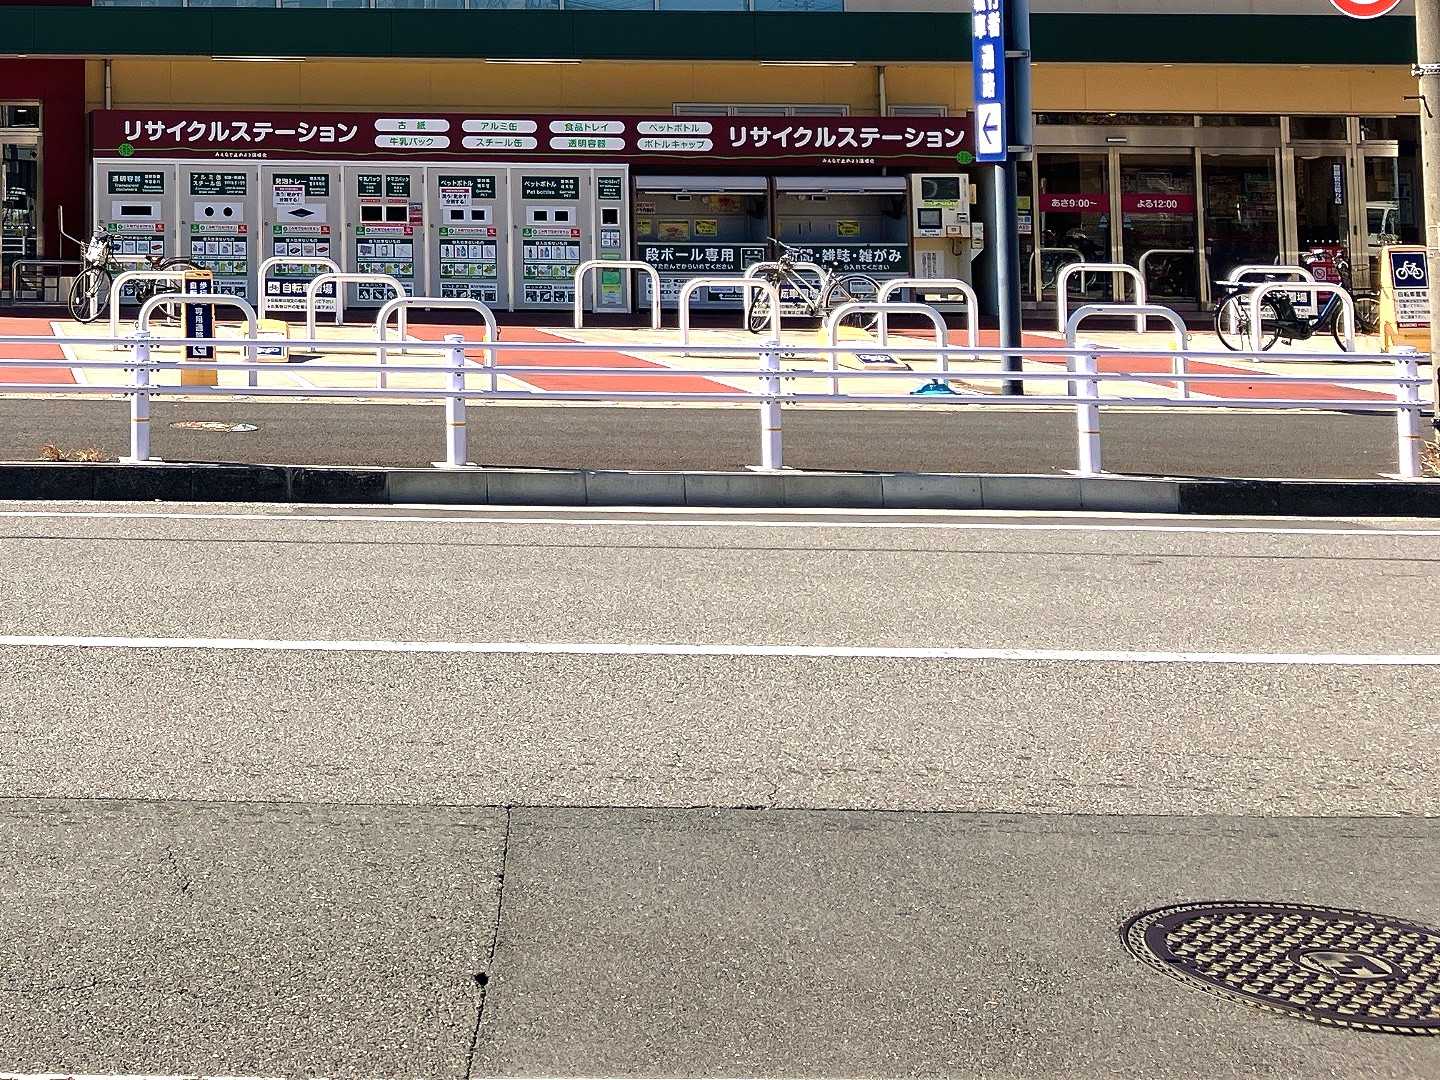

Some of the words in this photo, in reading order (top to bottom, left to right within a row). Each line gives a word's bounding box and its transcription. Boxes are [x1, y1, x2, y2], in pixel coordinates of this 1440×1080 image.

[480, 122, 517, 131] アルミ缶
[564, 123, 609, 132] 食品トレイ
[649, 124, 699, 133] ペットボトル
[124, 120, 358, 143] リサイクルステーション
[729, 125, 965, 148] リサイクルステーション
[389, 137, 434, 146] 牛乳パック
[476, 138, 522, 147] スチール缶
[568, 138, 606, 148] 透明容器
[644, 140, 705, 149] ボトルキャップ
[1136, 199, 1177, 208] よる12:00
[645, 247, 734, 262] 段ボール専用
